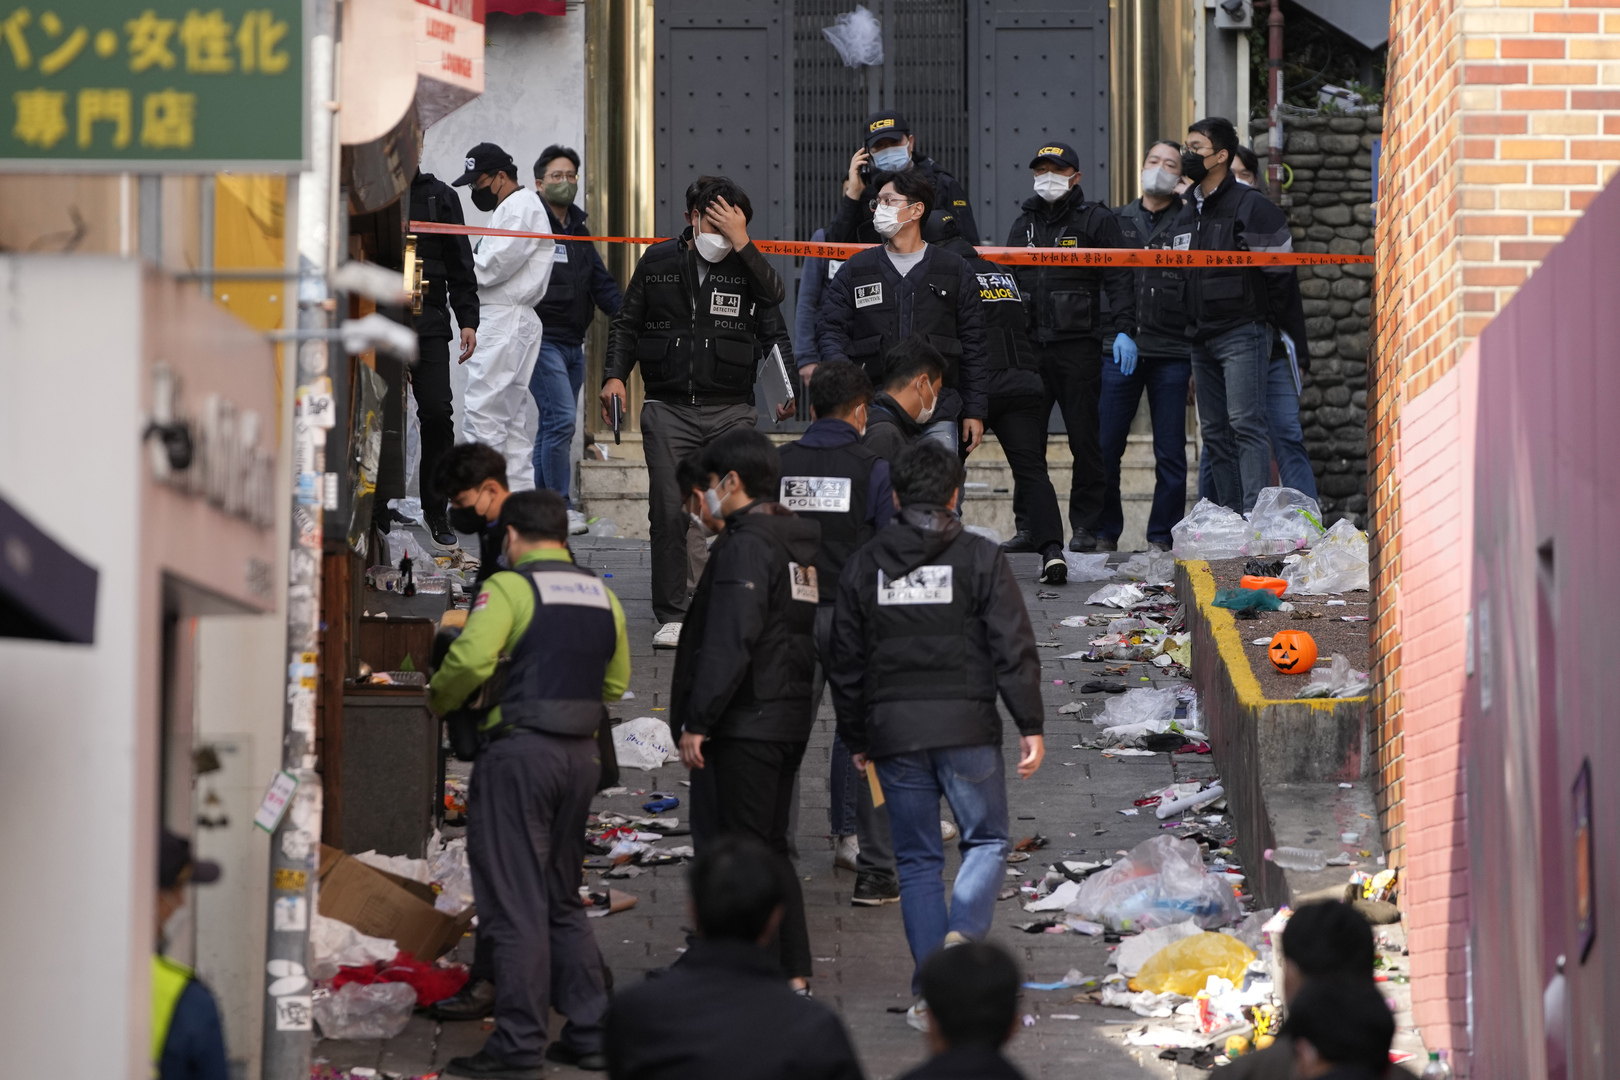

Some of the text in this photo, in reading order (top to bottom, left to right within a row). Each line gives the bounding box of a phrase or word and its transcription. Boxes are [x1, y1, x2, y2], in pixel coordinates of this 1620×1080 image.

[869, 118, 895, 133] KCSI
[1037, 146, 1064, 157] KCSI
[816, 245, 846, 256] 이선을
[1083, 252, 1113, 264] 이선을
[645, 274, 680, 283] POLICE
[709, 274, 747, 285] POLICE
[712, 306, 737, 314] DETECTIVE
[646, 320, 671, 330] OLICE
[789, 481, 842, 497] 경찰
[788, 499, 842, 508] POLICE
